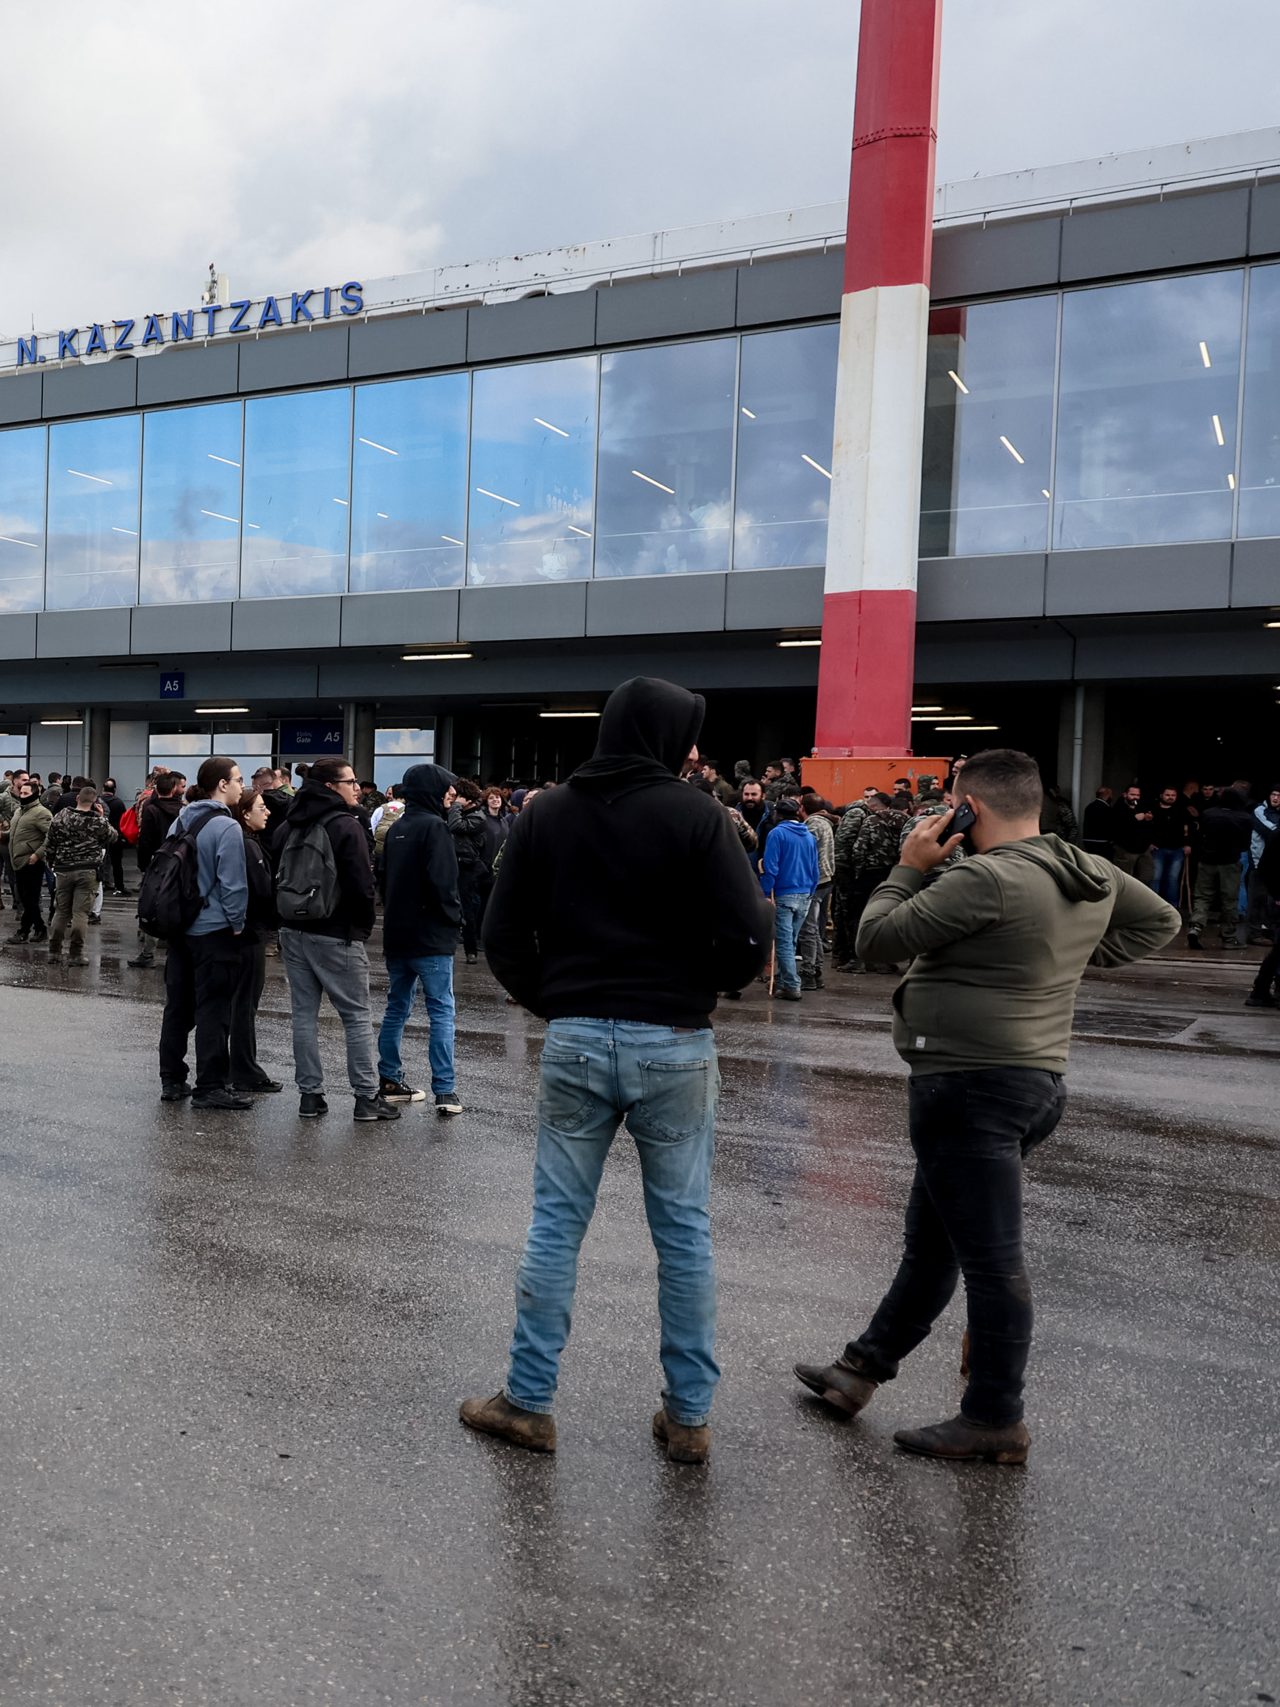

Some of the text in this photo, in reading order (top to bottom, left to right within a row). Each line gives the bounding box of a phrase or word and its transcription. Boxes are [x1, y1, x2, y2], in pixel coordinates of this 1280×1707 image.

[17, 335, 46, 366] N.
[58, 281, 363, 359] KAZANTZAKIS
[164, 680, 179, 692] A5
[324, 731, 341, 742] A5
